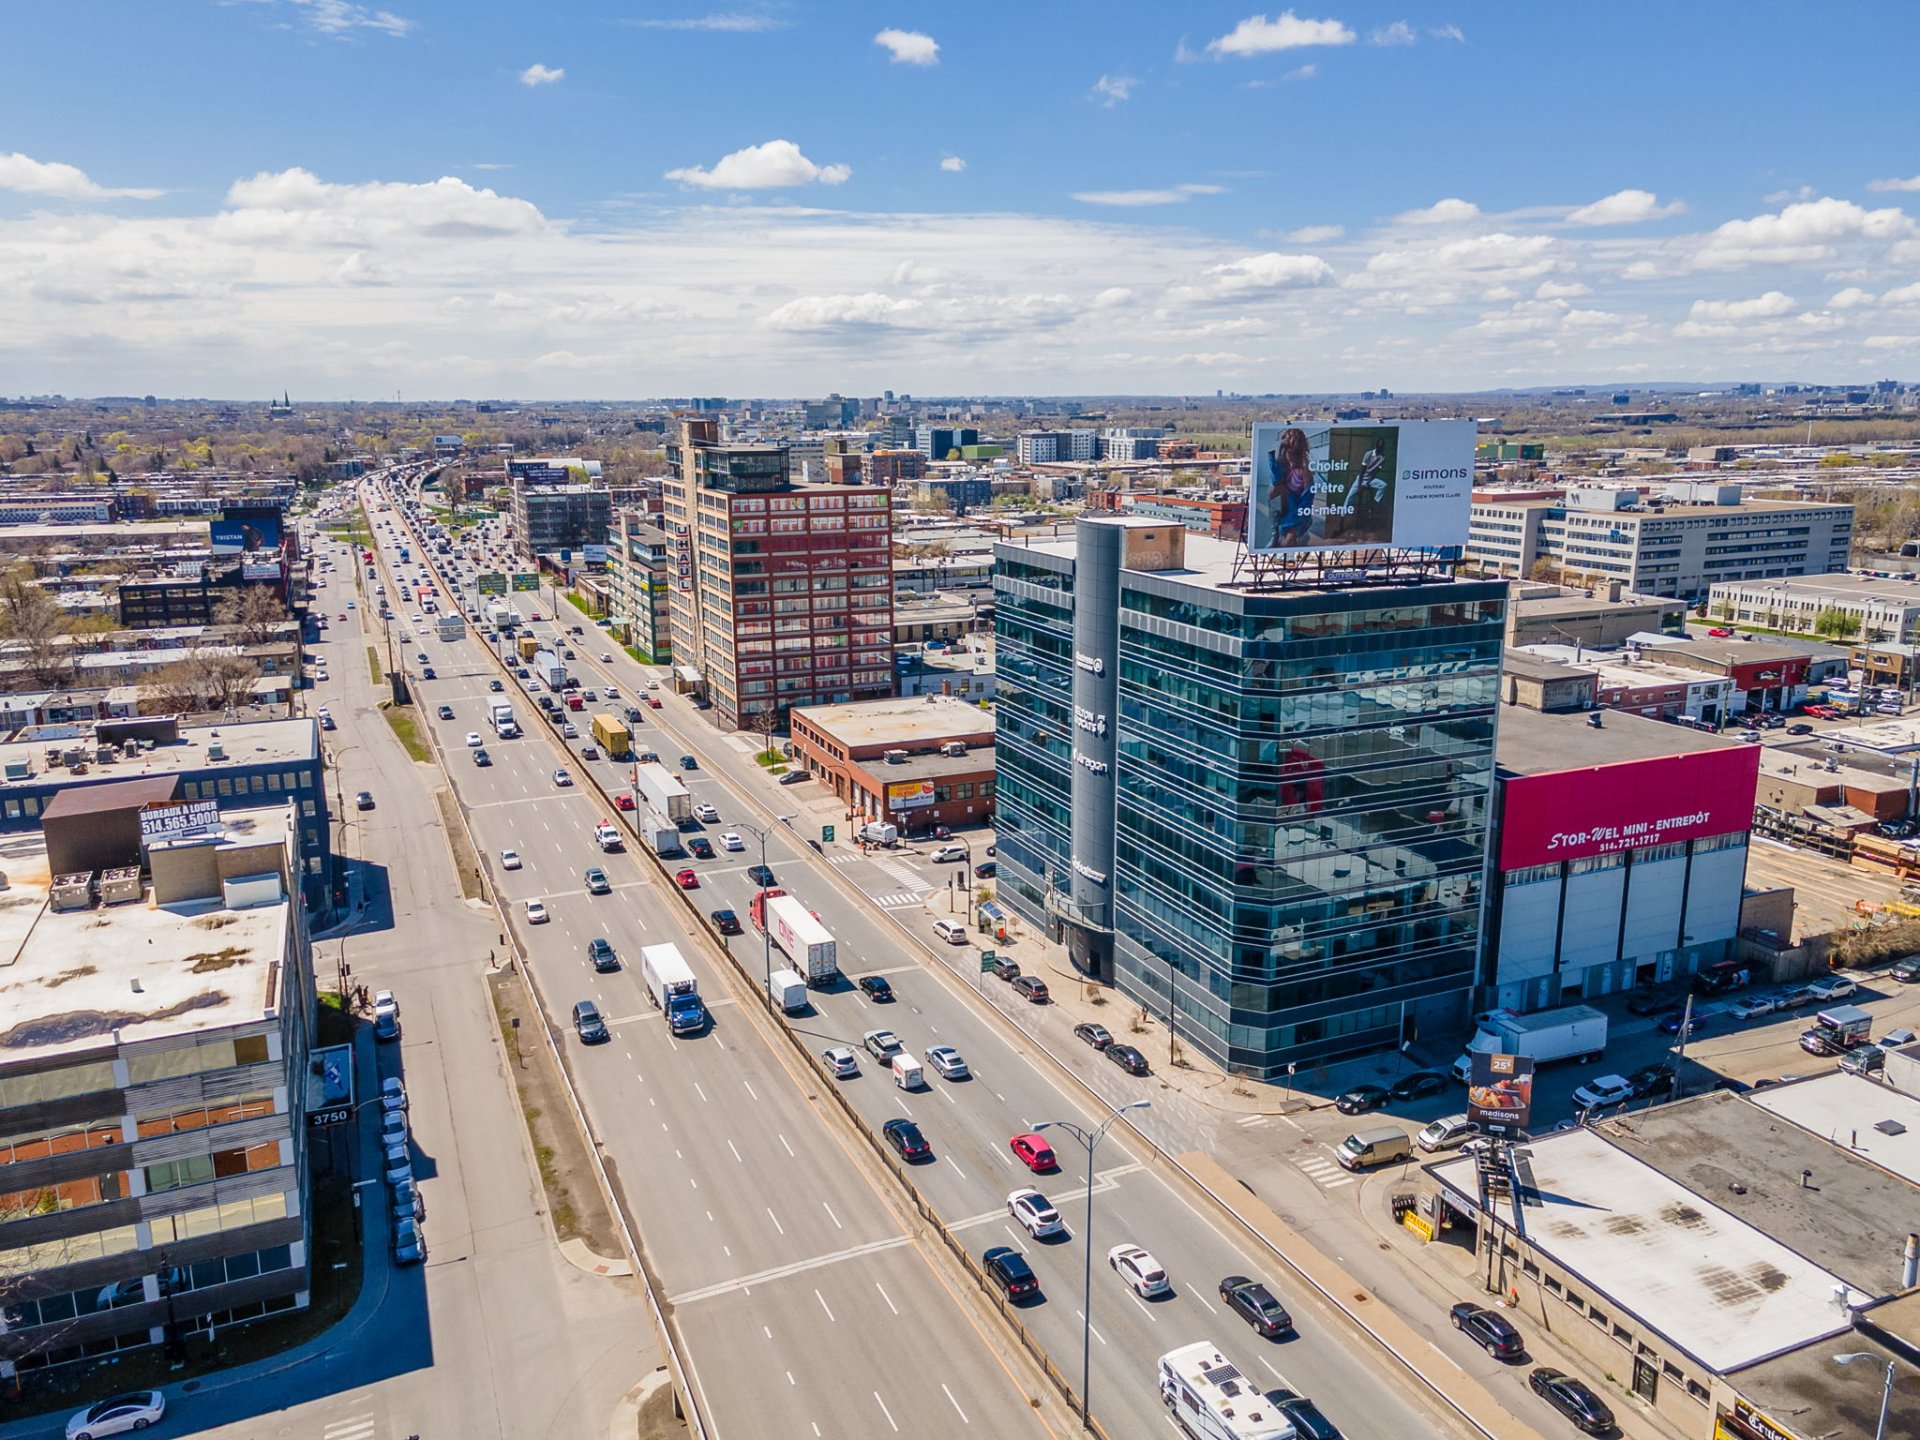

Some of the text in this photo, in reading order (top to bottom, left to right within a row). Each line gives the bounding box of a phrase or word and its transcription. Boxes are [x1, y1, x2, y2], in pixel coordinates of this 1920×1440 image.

[1308, 459, 1349, 471] Choisir
[1412, 467, 1468, 480] simons
[1310, 482, 1344, 494] d'être
[1297, 503, 1355, 517] soi-même
[140, 807, 181, 821] BUREAUX
[191, 801, 217, 813] LOUER
[142, 811, 219, 834] 514.565.5000
[1623, 822, 1648, 836] MINI
[1656, 811, 1710, 831] ENTREPÔT
[1600, 834, 1660, 851] 514.721.1717
[313, 1110, 347, 1125] 3750
[1480, 1109, 1519, 1120] madisons
